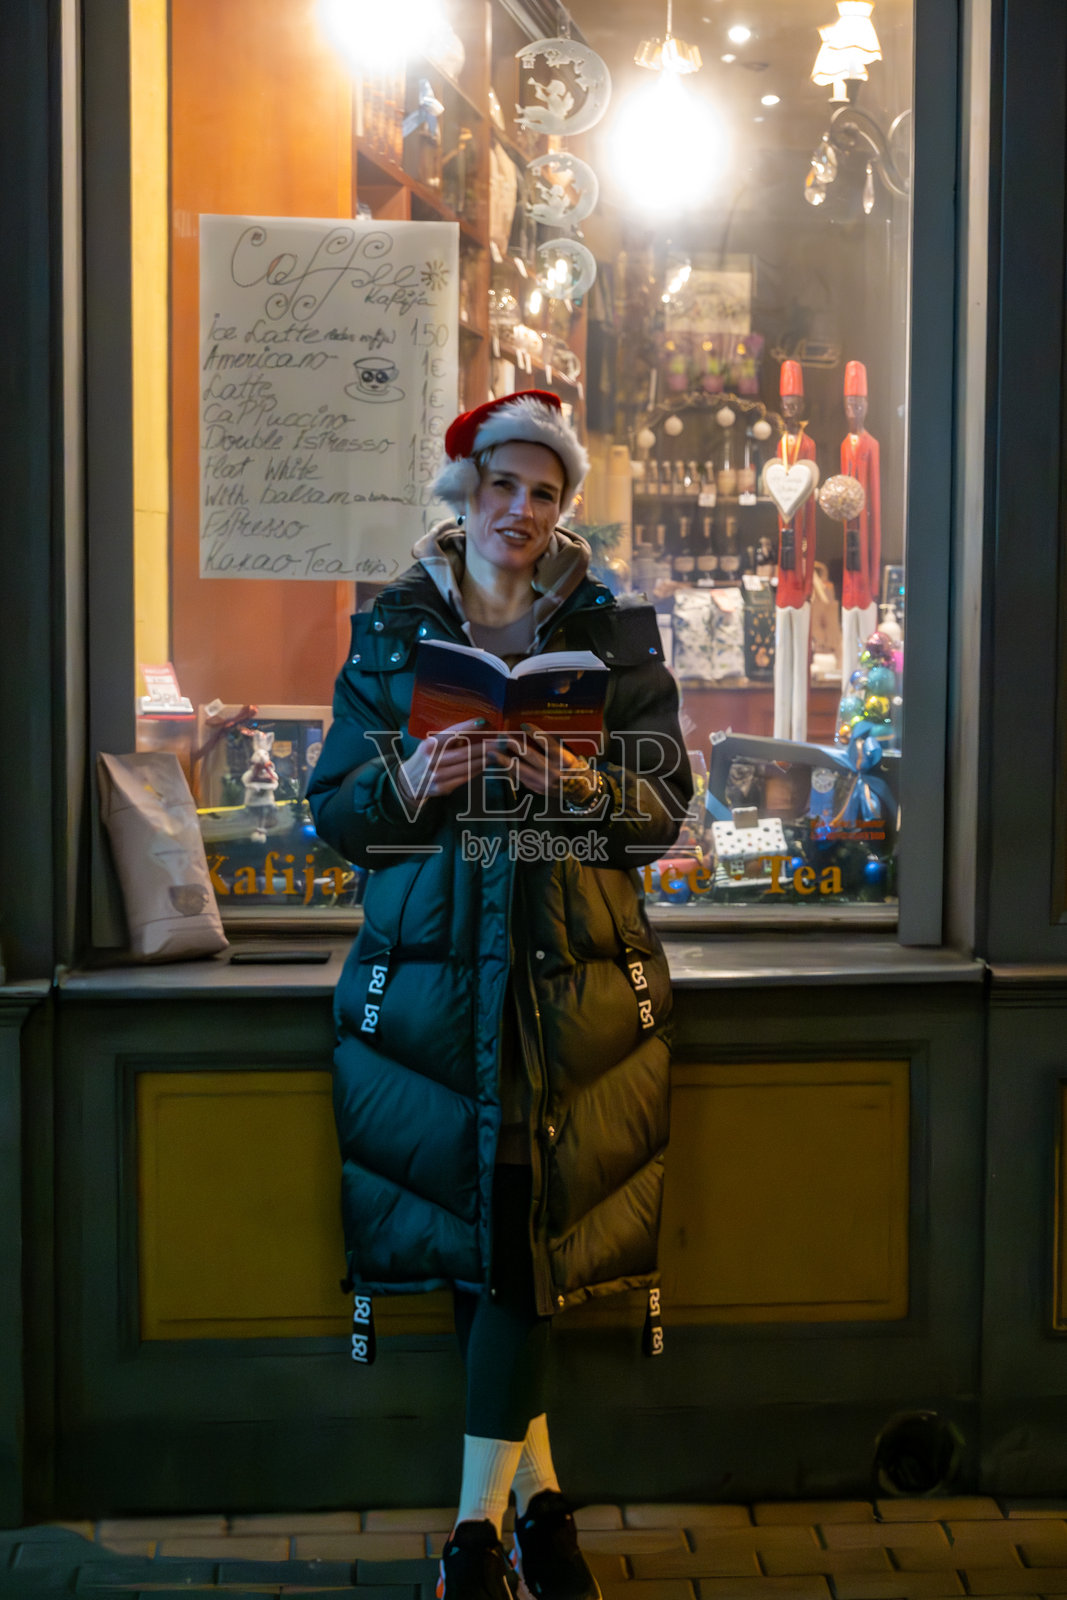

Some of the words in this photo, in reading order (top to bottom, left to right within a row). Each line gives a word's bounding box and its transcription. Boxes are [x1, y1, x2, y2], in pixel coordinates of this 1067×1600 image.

[231, 226, 418, 321] Coffee
[244, 319, 321, 344] Latte
[203, 344, 338, 370] Americano
[203, 373, 276, 401] Latte
[203, 423, 283, 451] Double
[264, 453, 324, 481] White
[759, 855, 844, 895] Tea
